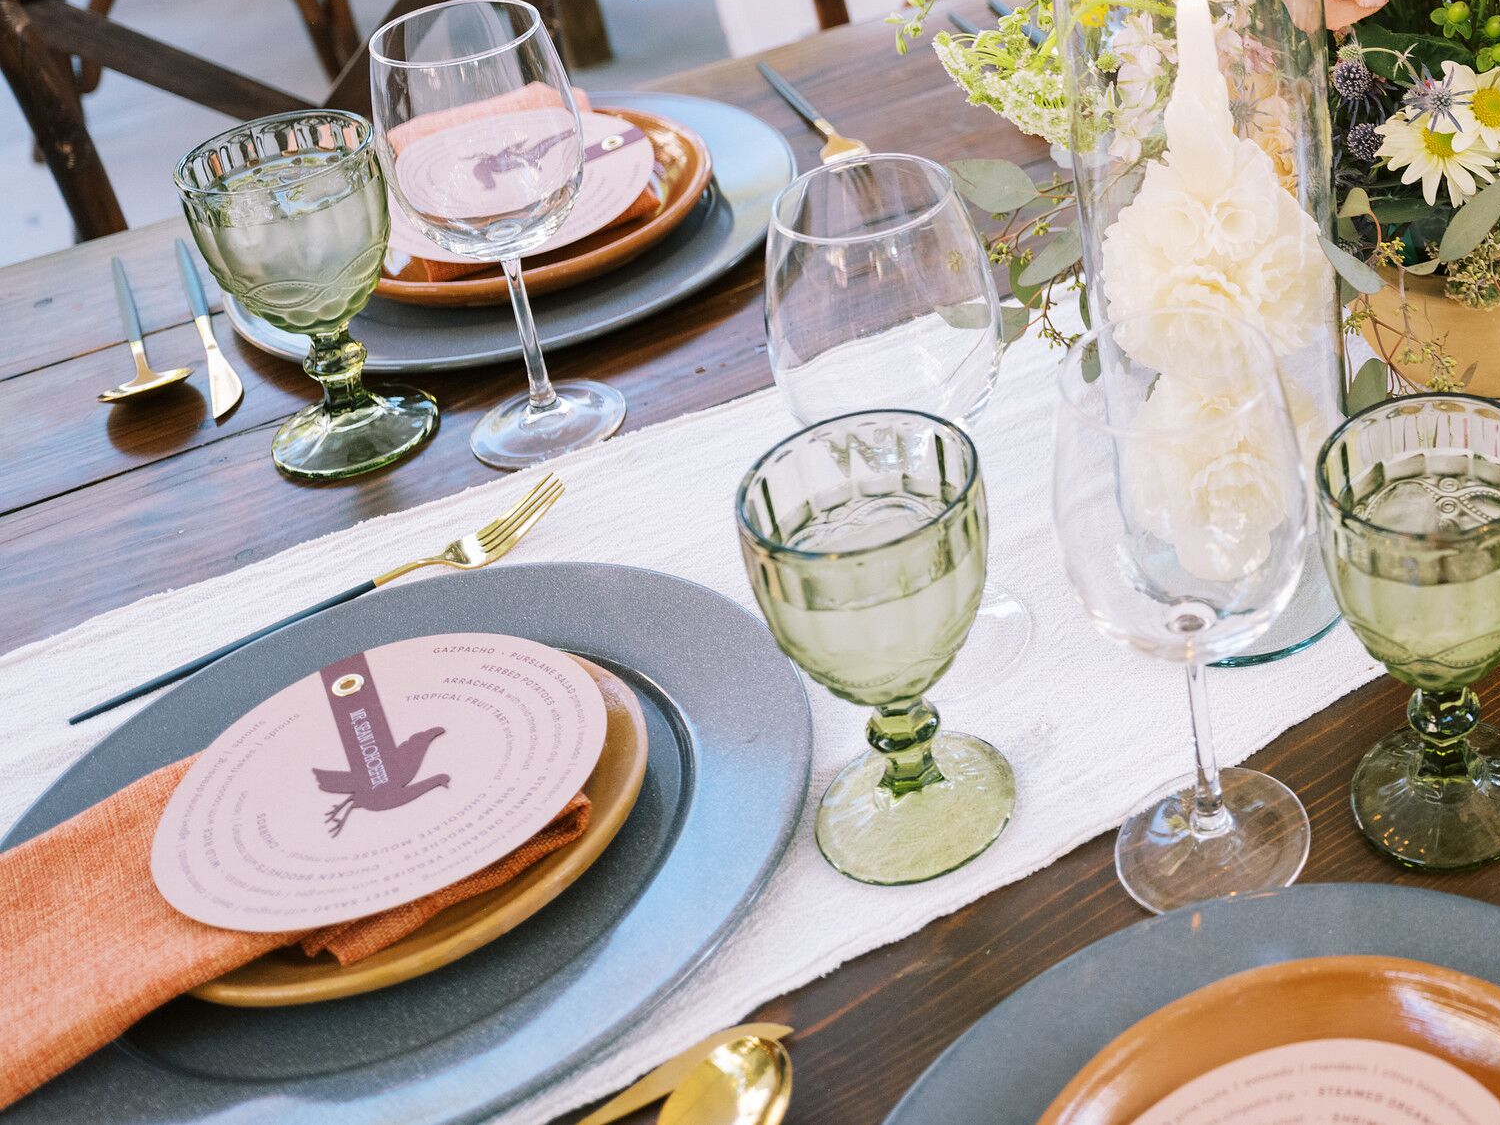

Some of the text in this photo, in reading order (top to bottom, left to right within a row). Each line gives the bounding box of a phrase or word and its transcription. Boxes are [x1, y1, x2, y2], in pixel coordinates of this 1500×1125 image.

[433, 645, 495, 655] GAZPACHO
[480, 663, 521, 680] HERBED
[510, 651, 557, 676] PURSLANE
[443, 676, 505, 695] ARRACHERA
[521, 677, 555, 706] POTATOES
[554, 674, 577, 695] SALAD
[405, 693, 463, 703] TROPICAL
[464, 696, 494, 711] FRUIT
[263, 713, 301, 741] sprouts
[491, 705, 510, 727] TART
[232, 720, 266, 748] sprouts
[477, 786, 516, 822] SHRIMP
[505, 775, 546, 817] STEAMED
[420, 792, 487, 839] CHOCOLATE
[202, 827, 214, 848] RICE
[257, 812, 280, 850] CHURROS
[448, 818, 504, 855] ORGANIC
[205, 849, 222, 869] WILD
[351, 838, 412, 860] MOUSSE
[255, 864, 313, 881] BROCHETS
[318, 864, 380, 881] CHICKEN
[382, 854, 444, 881] VEGGIES
[312, 897, 358, 914] SALAD
